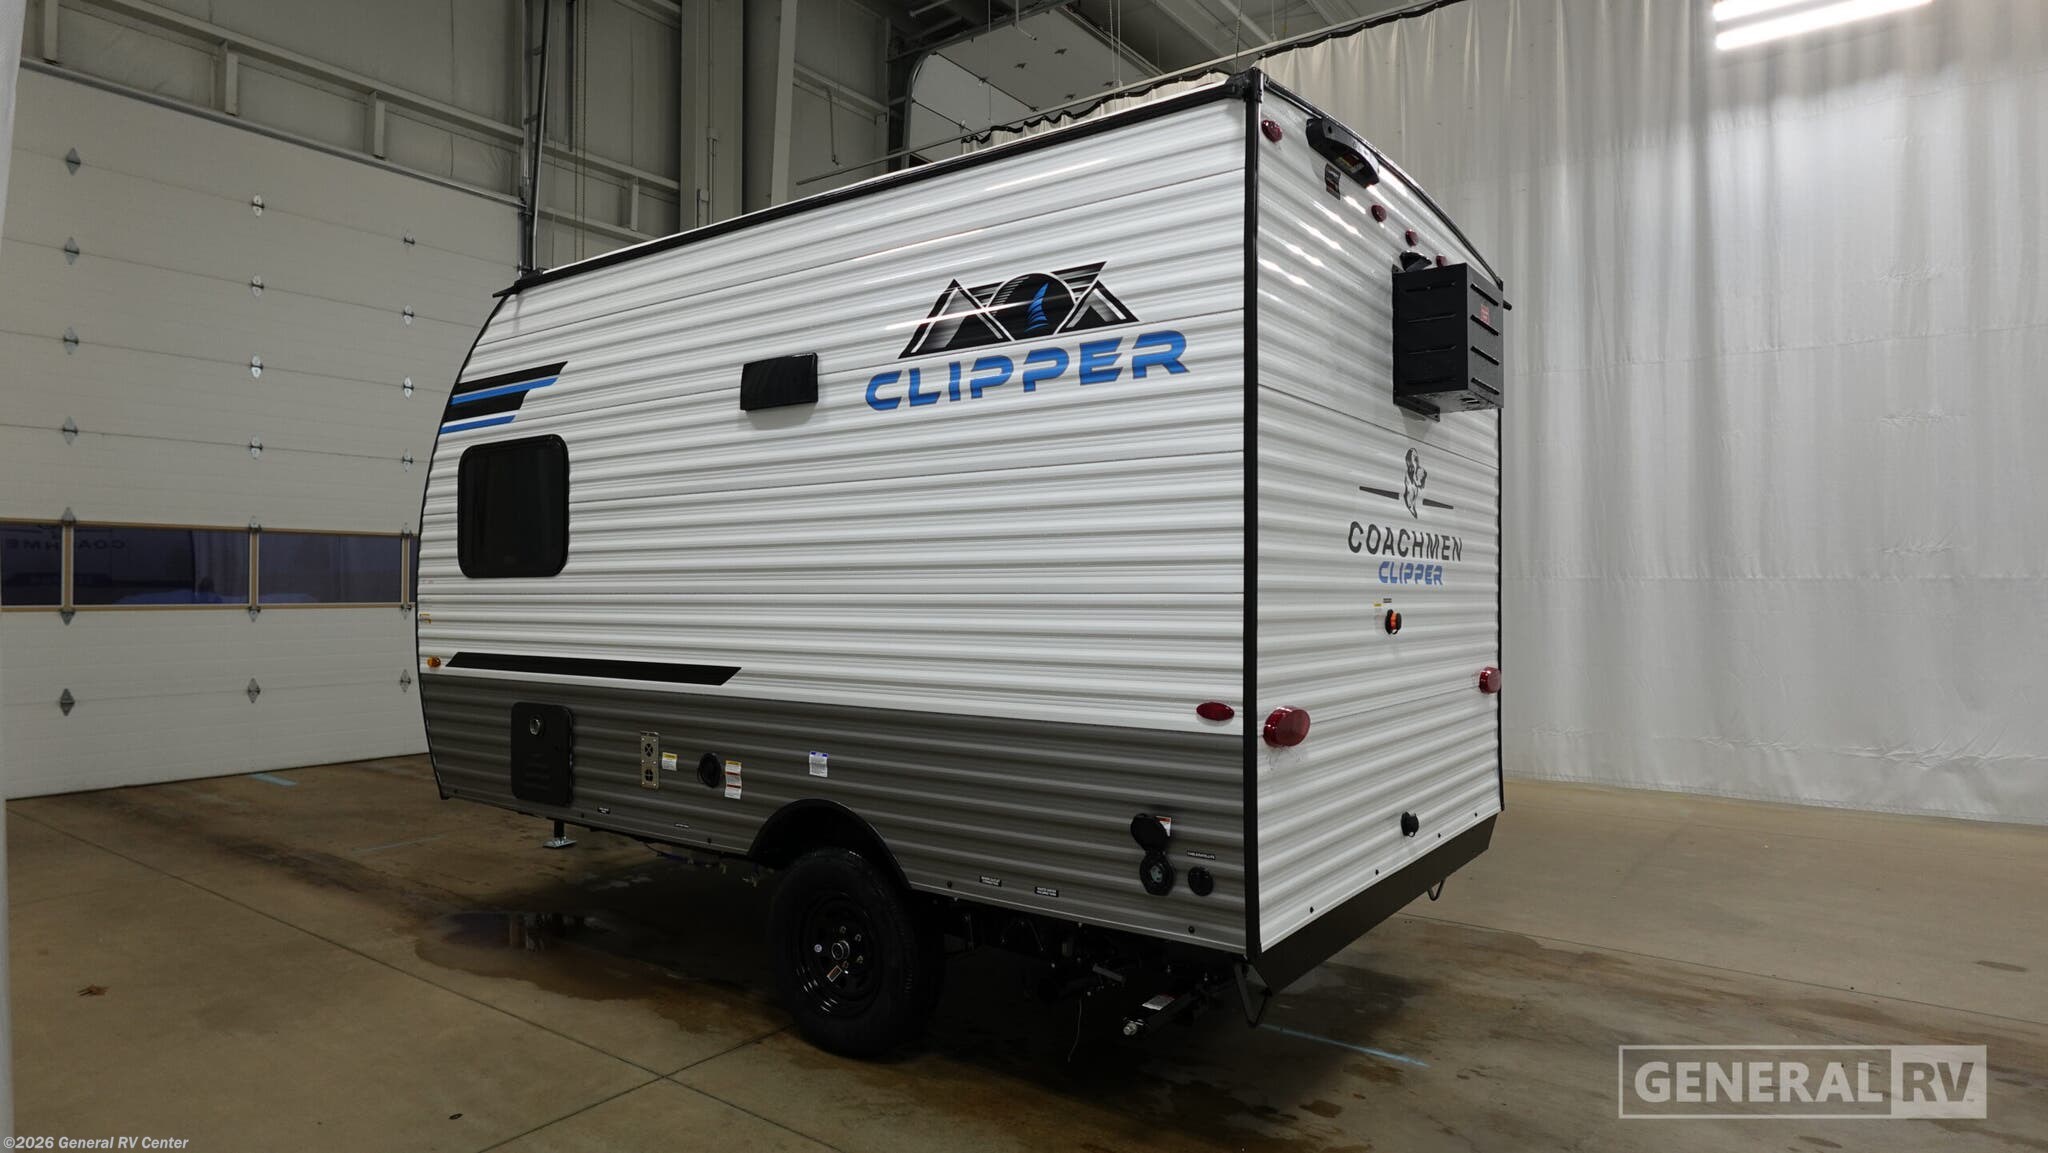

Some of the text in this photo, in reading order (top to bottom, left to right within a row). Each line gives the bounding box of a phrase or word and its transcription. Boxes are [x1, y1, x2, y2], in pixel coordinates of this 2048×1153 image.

[865, 330, 1189, 411] CLIPPER
[1348, 521, 1462, 561] COACHMEN
[1378, 562, 1443, 585] CLIPPER
